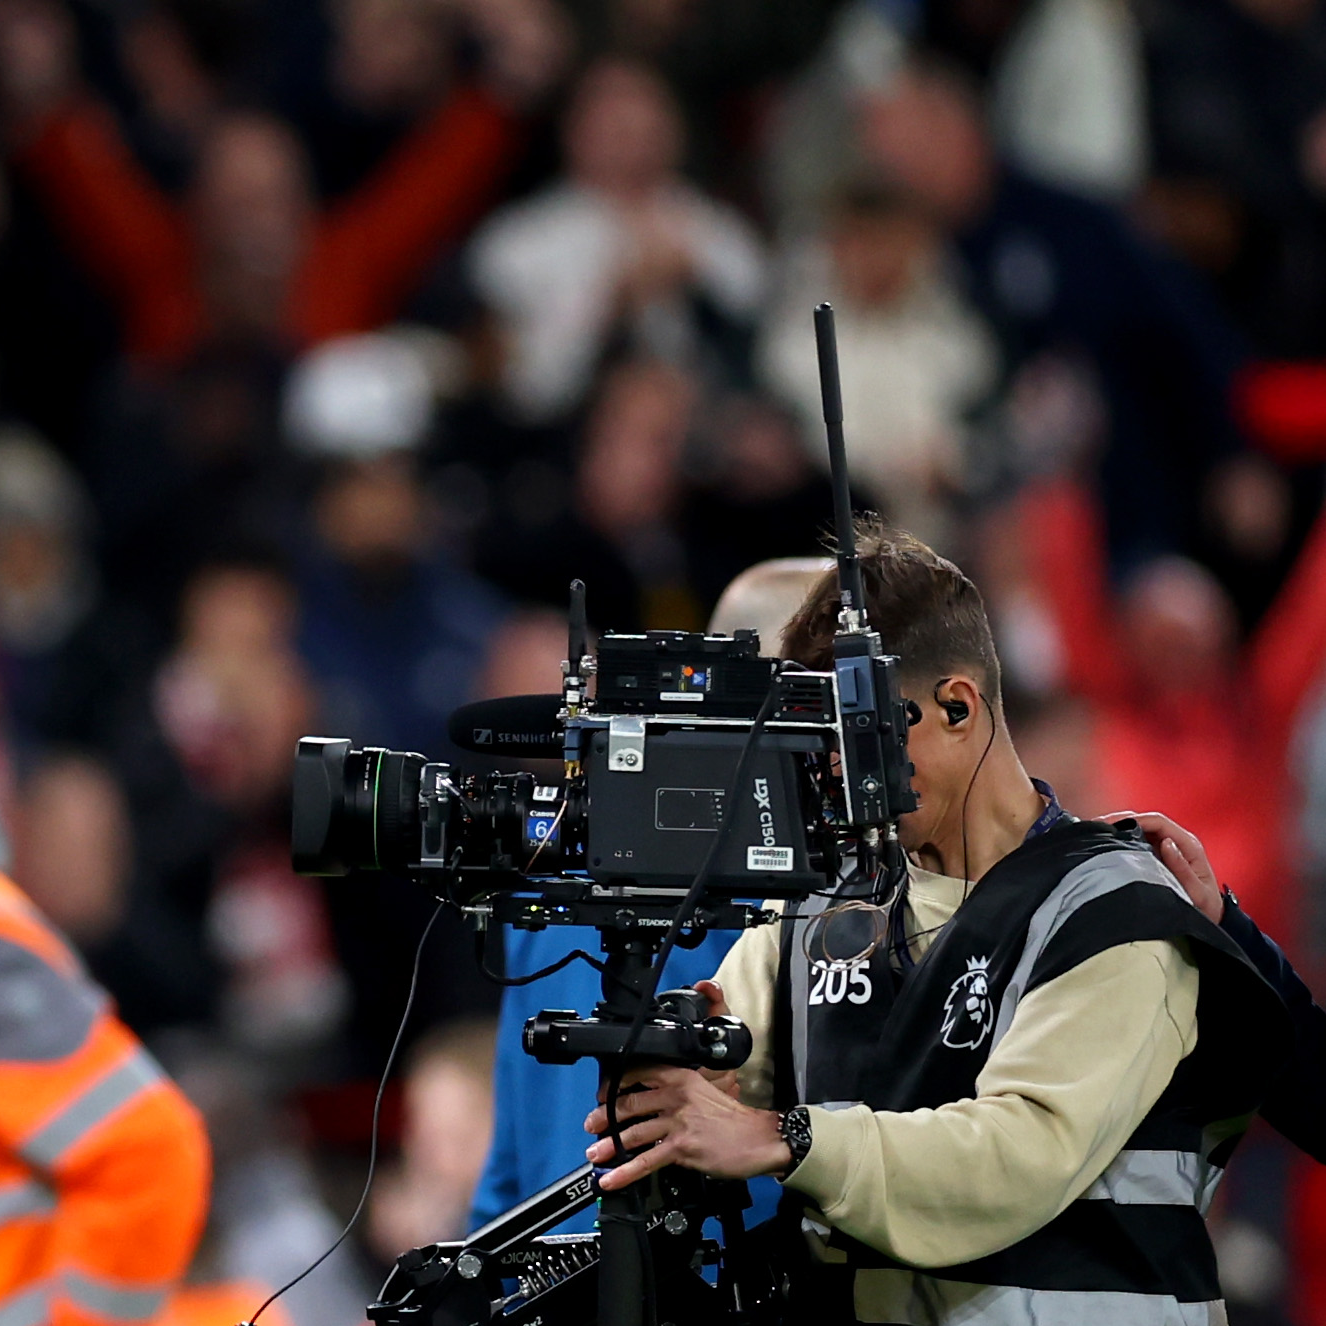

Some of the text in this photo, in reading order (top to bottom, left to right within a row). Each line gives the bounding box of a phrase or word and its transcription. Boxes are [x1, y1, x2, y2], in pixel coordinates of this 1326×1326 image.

[498, 732, 551, 744] SENNHEI
[529, 810, 556, 818] Canon
[535, 820, 548, 838] 6
[759, 811, 776, 847] C150
[808, 958, 873, 1006] 205
